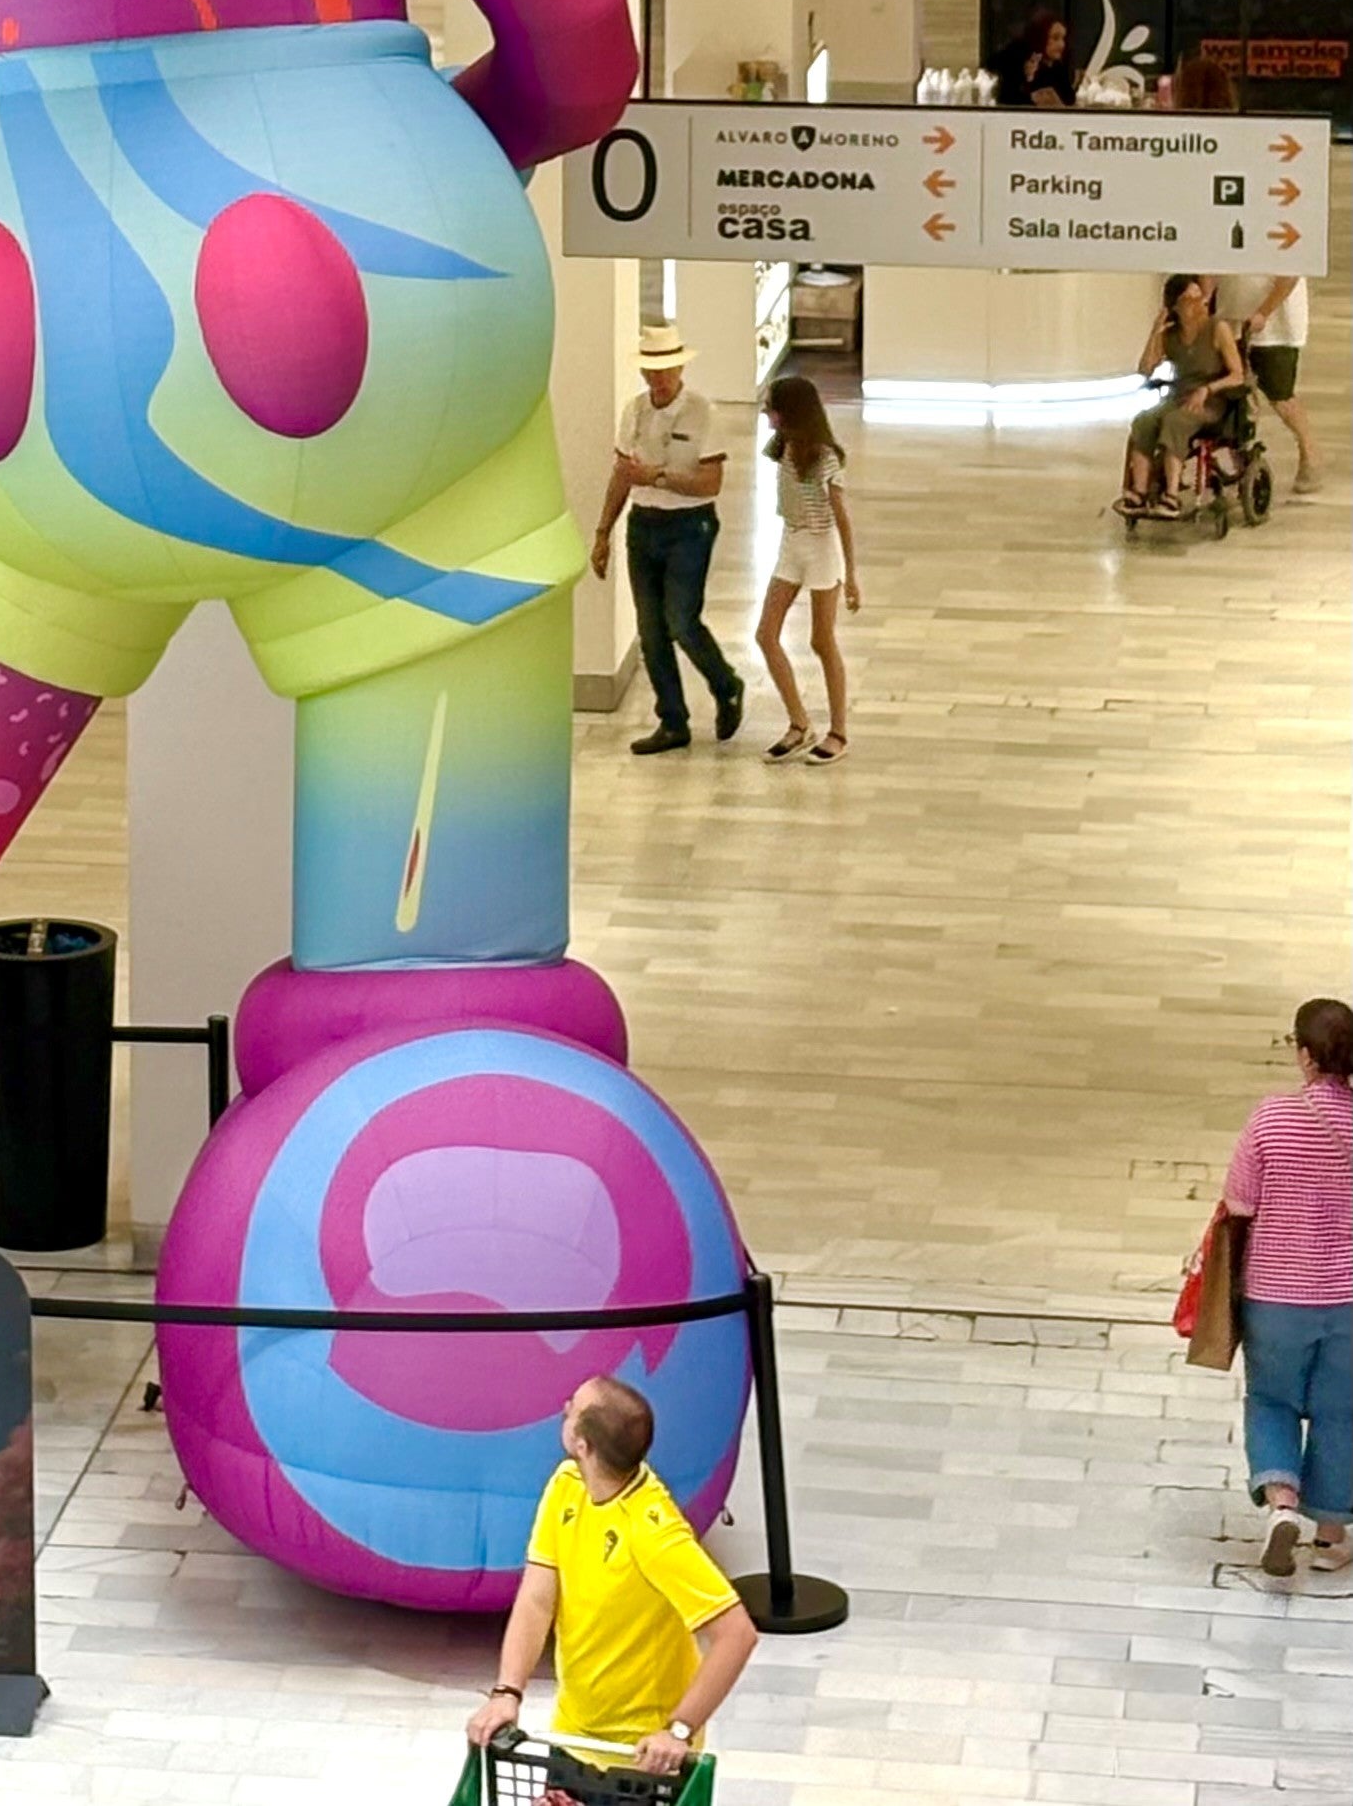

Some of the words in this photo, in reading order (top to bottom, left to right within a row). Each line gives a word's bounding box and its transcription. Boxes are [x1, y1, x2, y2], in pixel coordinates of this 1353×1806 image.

[716, 131, 787, 144] ALVARO
[819, 133, 899, 147] MORENO
[1011, 130, 1064, 150] Rda.
[1072, 130, 1218, 157] Tamarguillo
[591, 128, 658, 222] 0
[717, 169, 875, 191] MERCADONA
[1010, 174, 1103, 200] Parking
[717, 203, 782, 216] espaço
[717, 217, 811, 241] casa
[1008, 217, 1061, 238] Sala
[1068, 219, 1178, 242] lactancia
